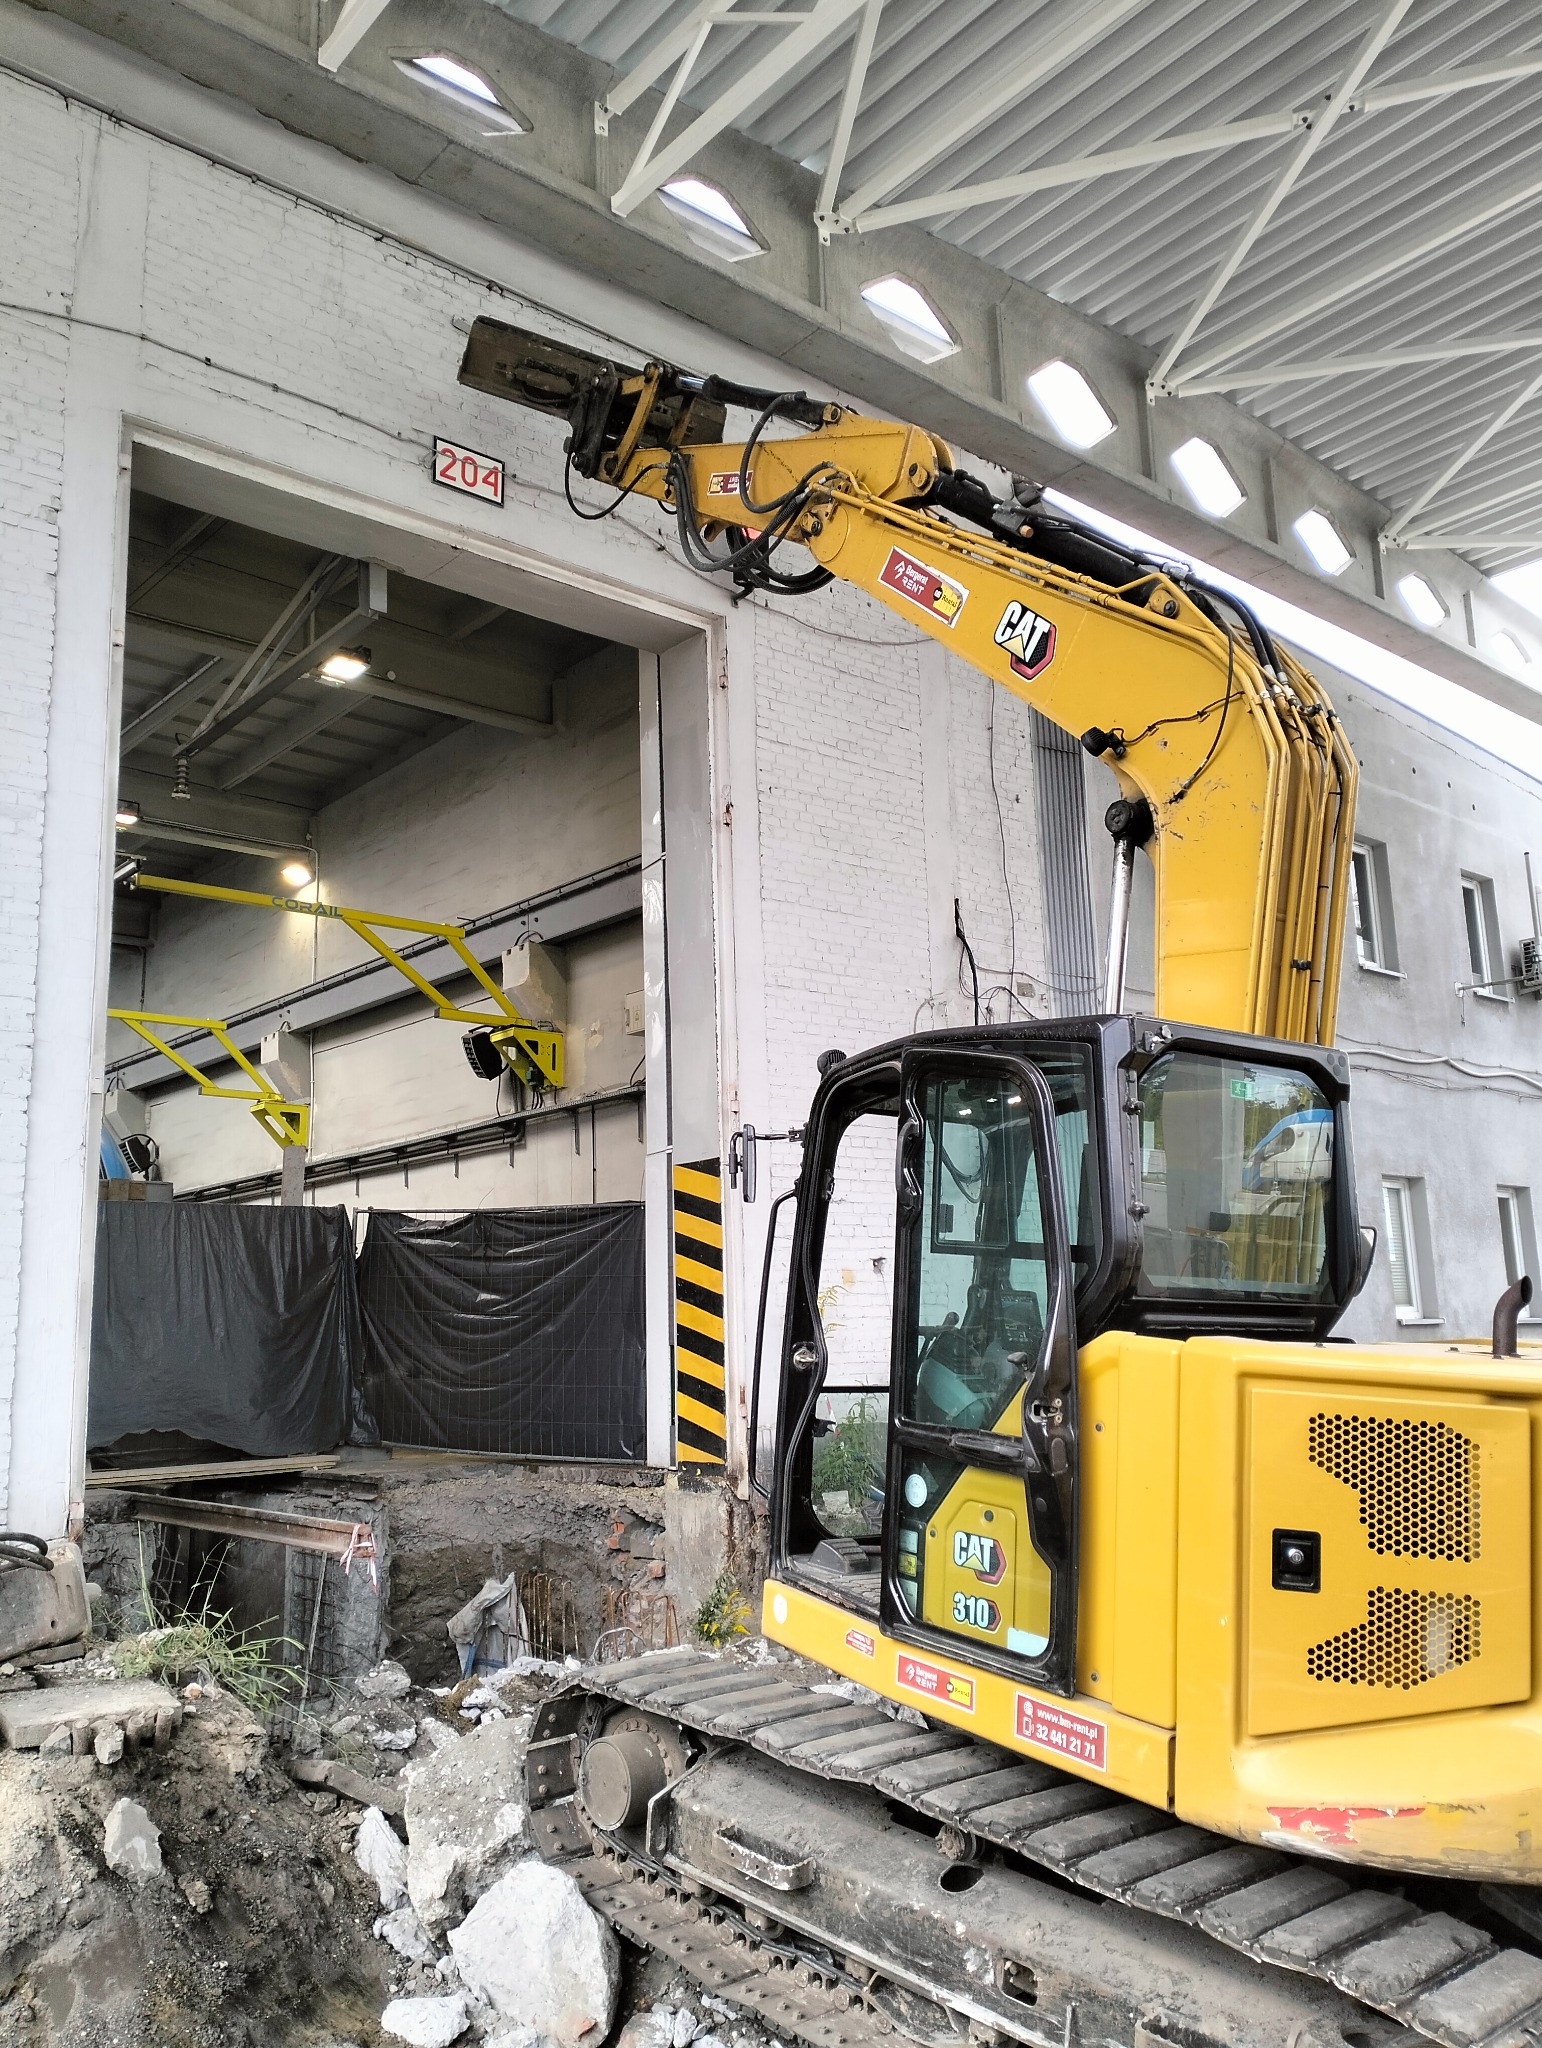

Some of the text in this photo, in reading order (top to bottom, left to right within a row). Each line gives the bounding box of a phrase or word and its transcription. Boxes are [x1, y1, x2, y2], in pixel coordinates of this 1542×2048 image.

[440, 447, 499, 497] 204
[902, 576, 925, 595] RENT
[905, 564, 929, 586] Bergerat
[994, 600, 1051, 663] CAT
[272, 897, 343, 918] CORAIL
[953, 1530, 994, 1573] CAT
[953, 1591, 990, 1628] 310
[916, 1676, 938, 1692] RENT
[1036, 1708, 1098, 1740] www.bm-rent.pl
[1036, 1723, 1096, 1760] 32 441 21 71
